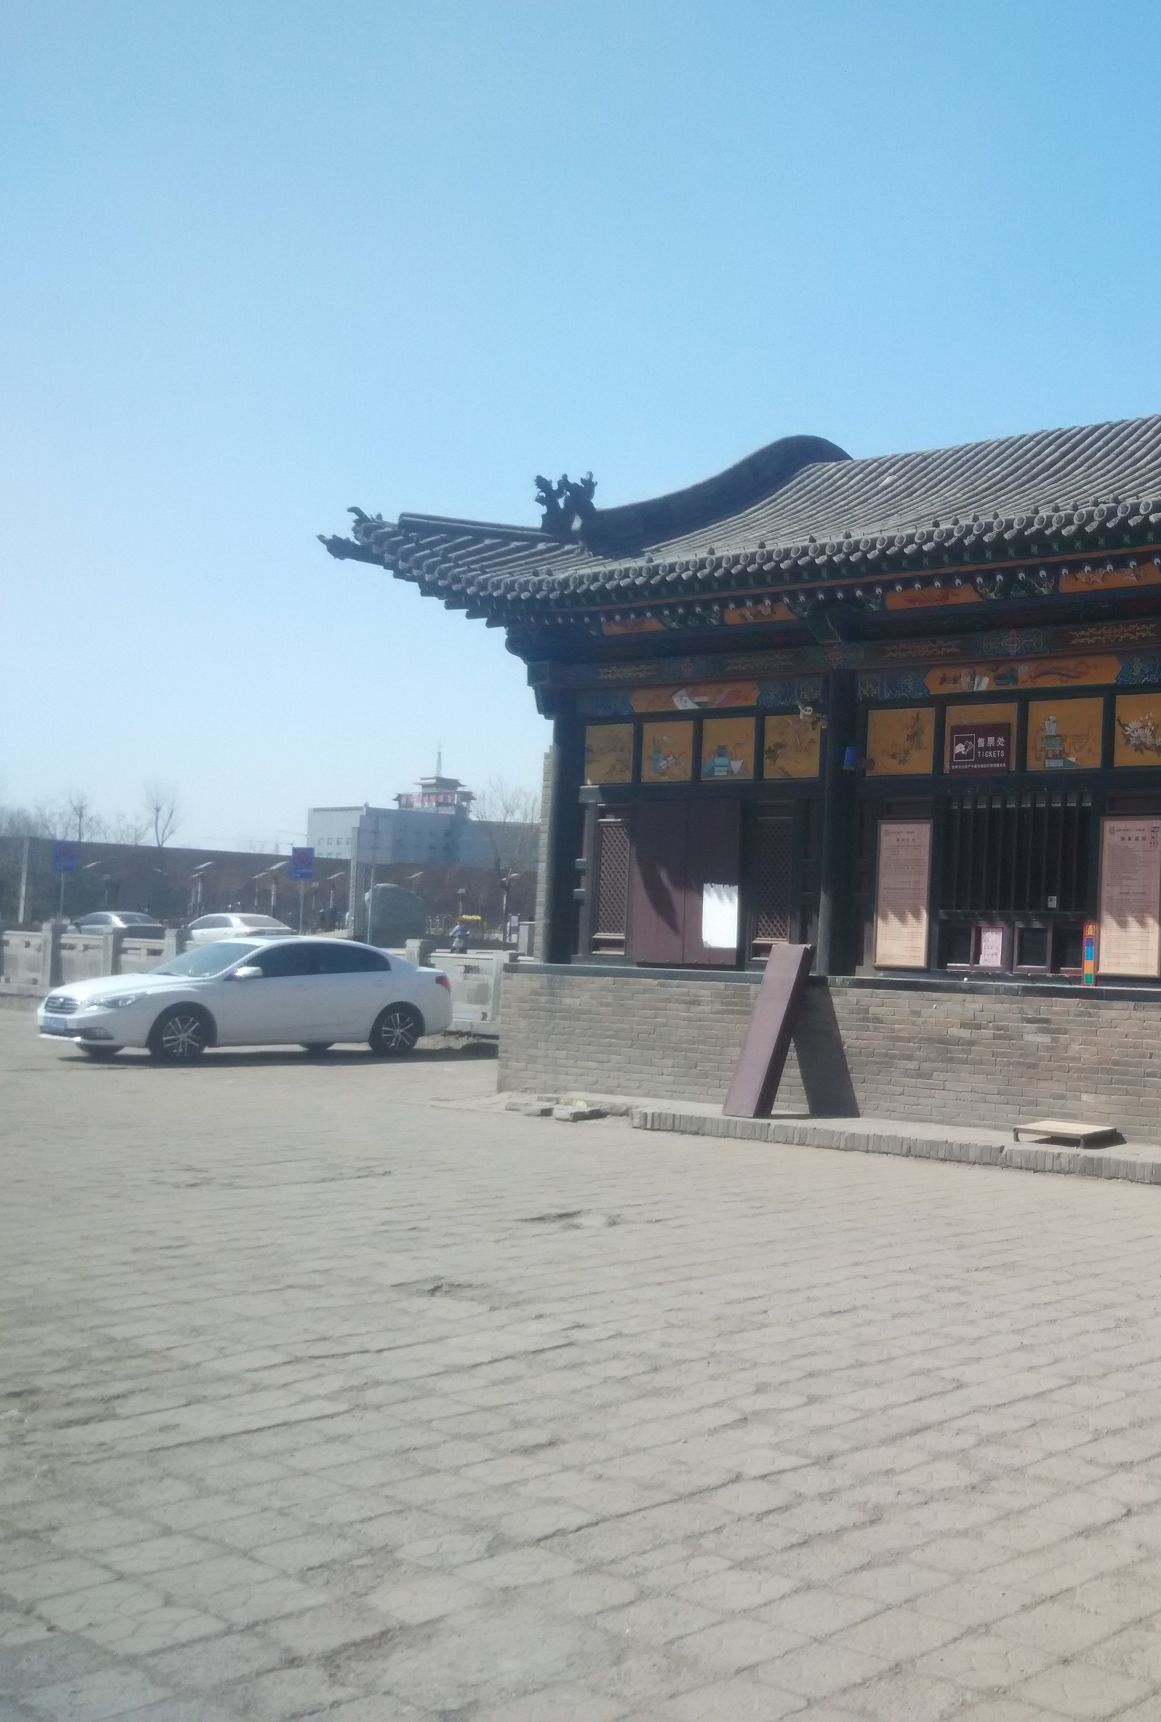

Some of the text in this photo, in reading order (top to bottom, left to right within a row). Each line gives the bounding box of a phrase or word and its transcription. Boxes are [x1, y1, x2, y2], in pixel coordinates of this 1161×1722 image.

[977, 736, 1005, 748] 售票处
[977, 750, 1005, 758] TICKETS
